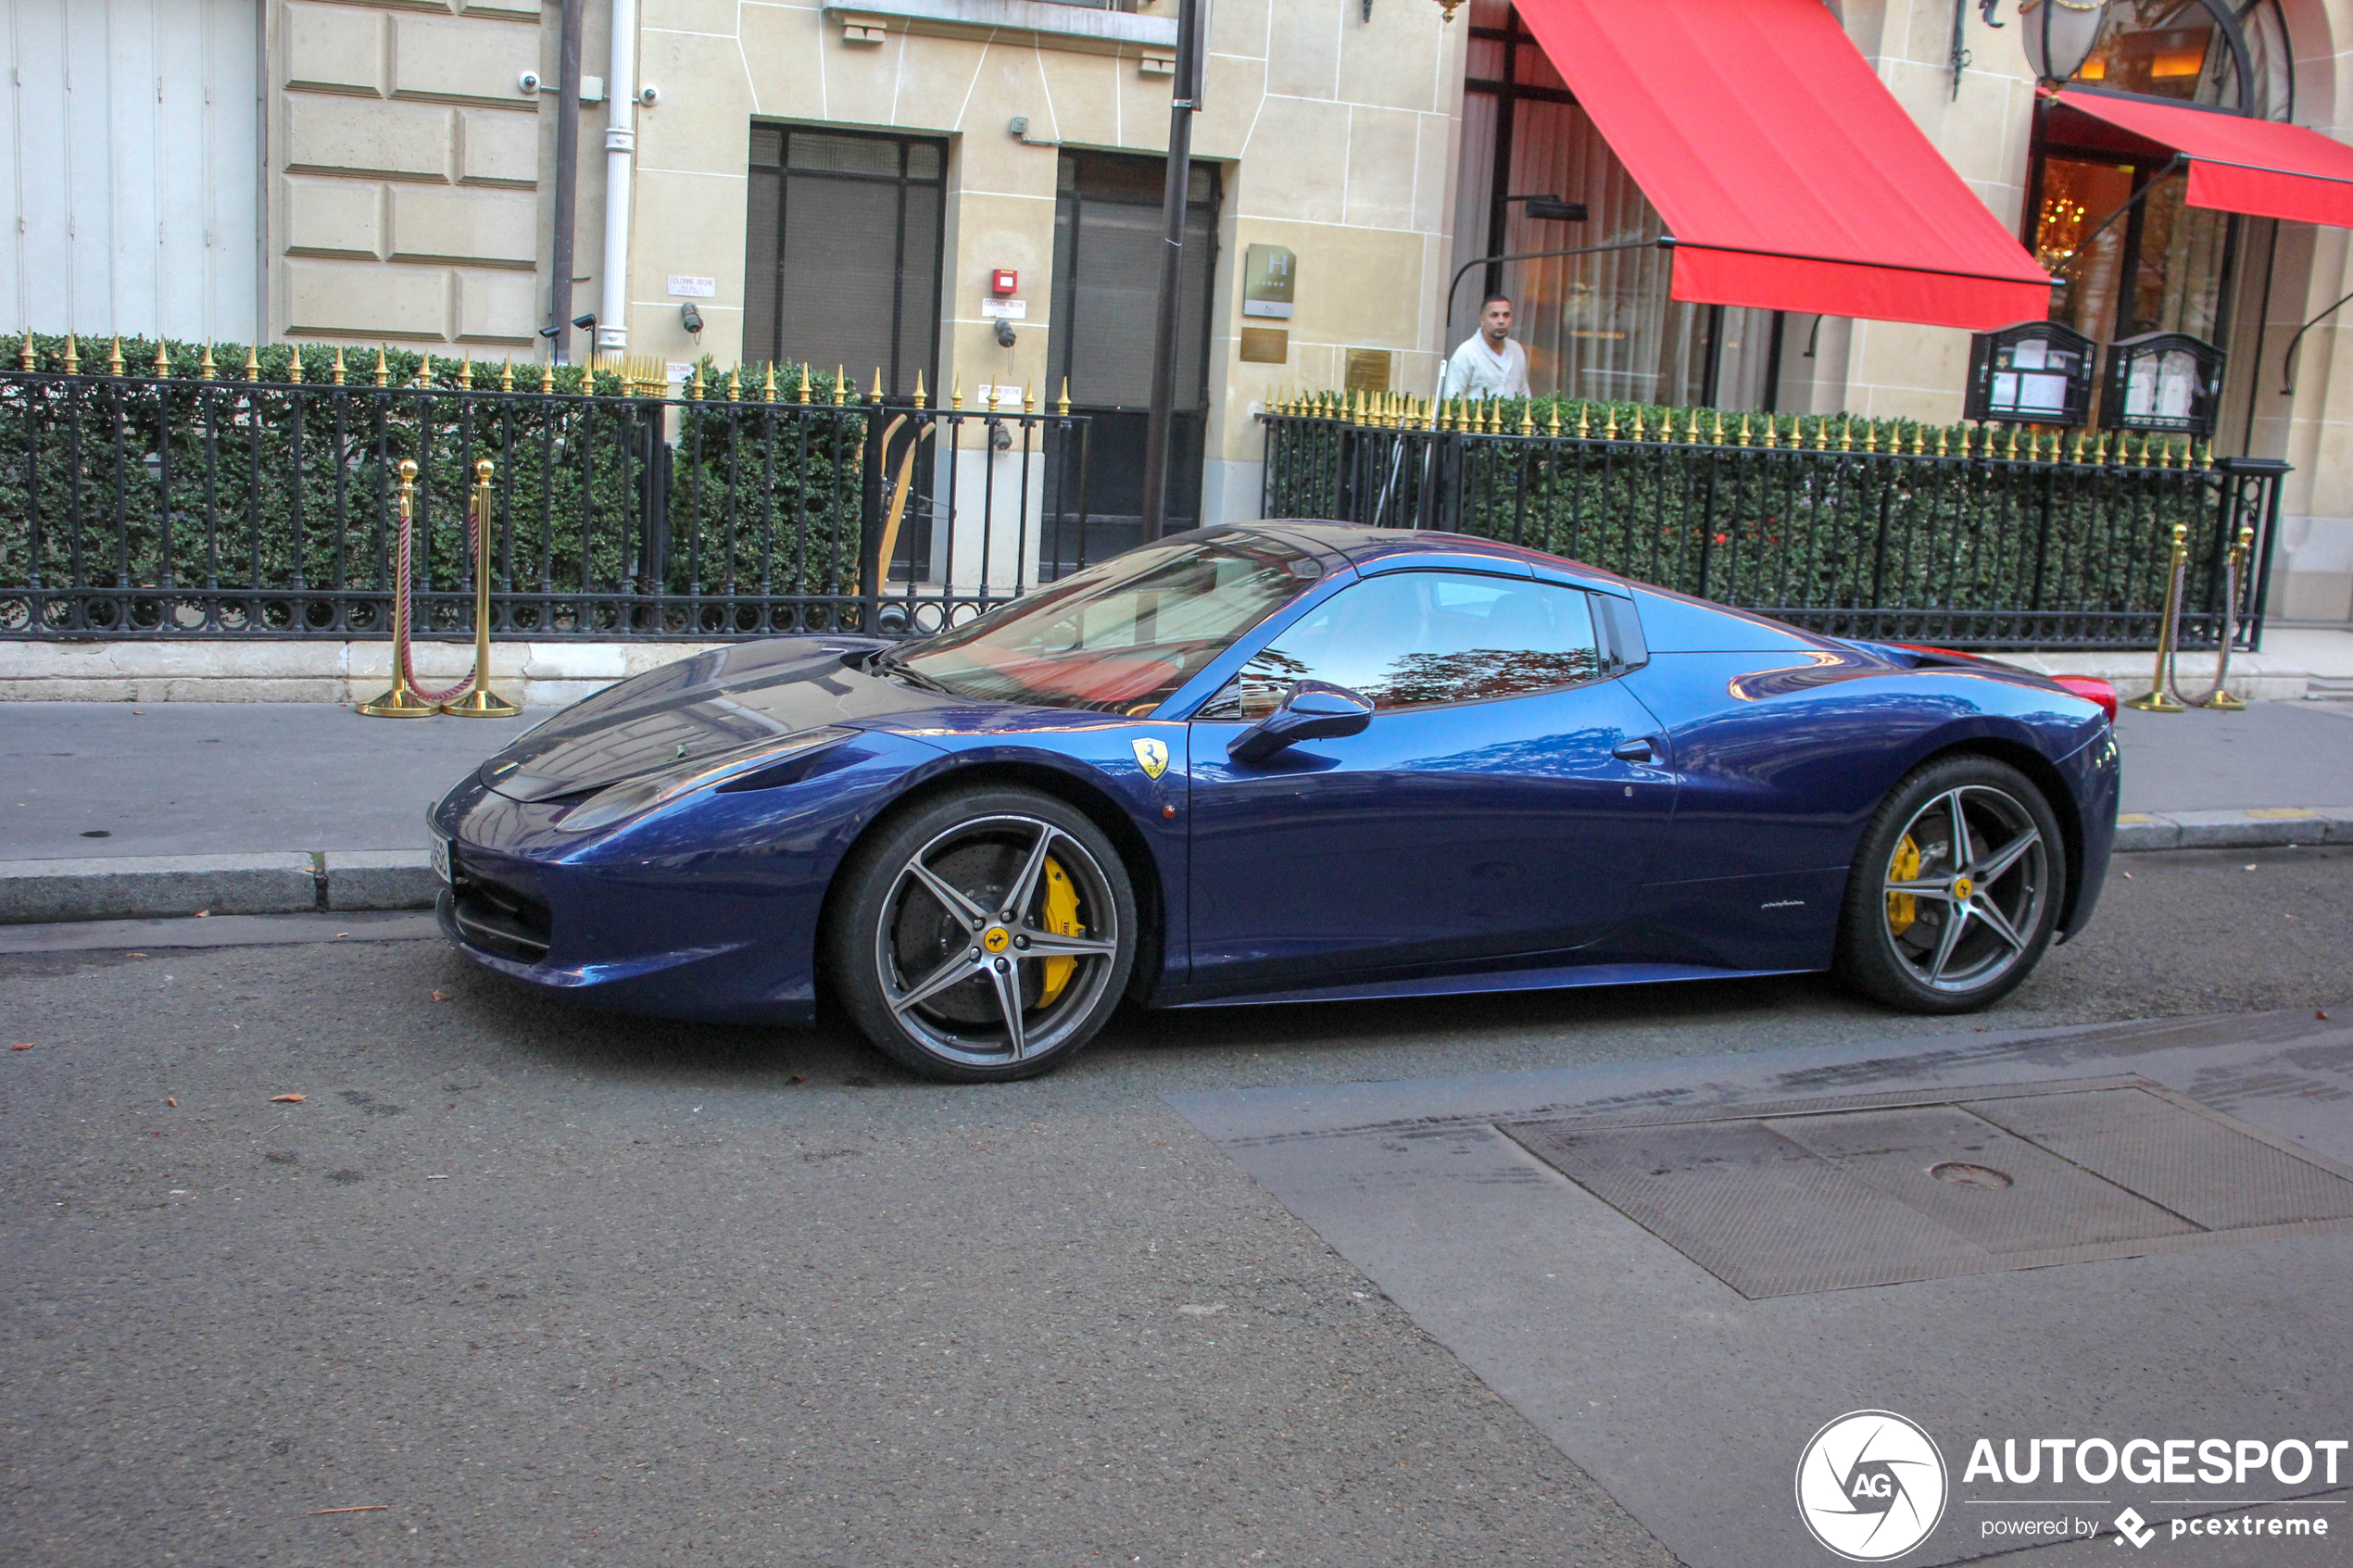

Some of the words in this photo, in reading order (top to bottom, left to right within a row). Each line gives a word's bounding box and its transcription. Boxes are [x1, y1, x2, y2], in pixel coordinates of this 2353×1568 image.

[1267, 253, 1289, 276] H
[669, 277, 695, 285] COLONNE
[666, 364, 692, 372] COLONNE
